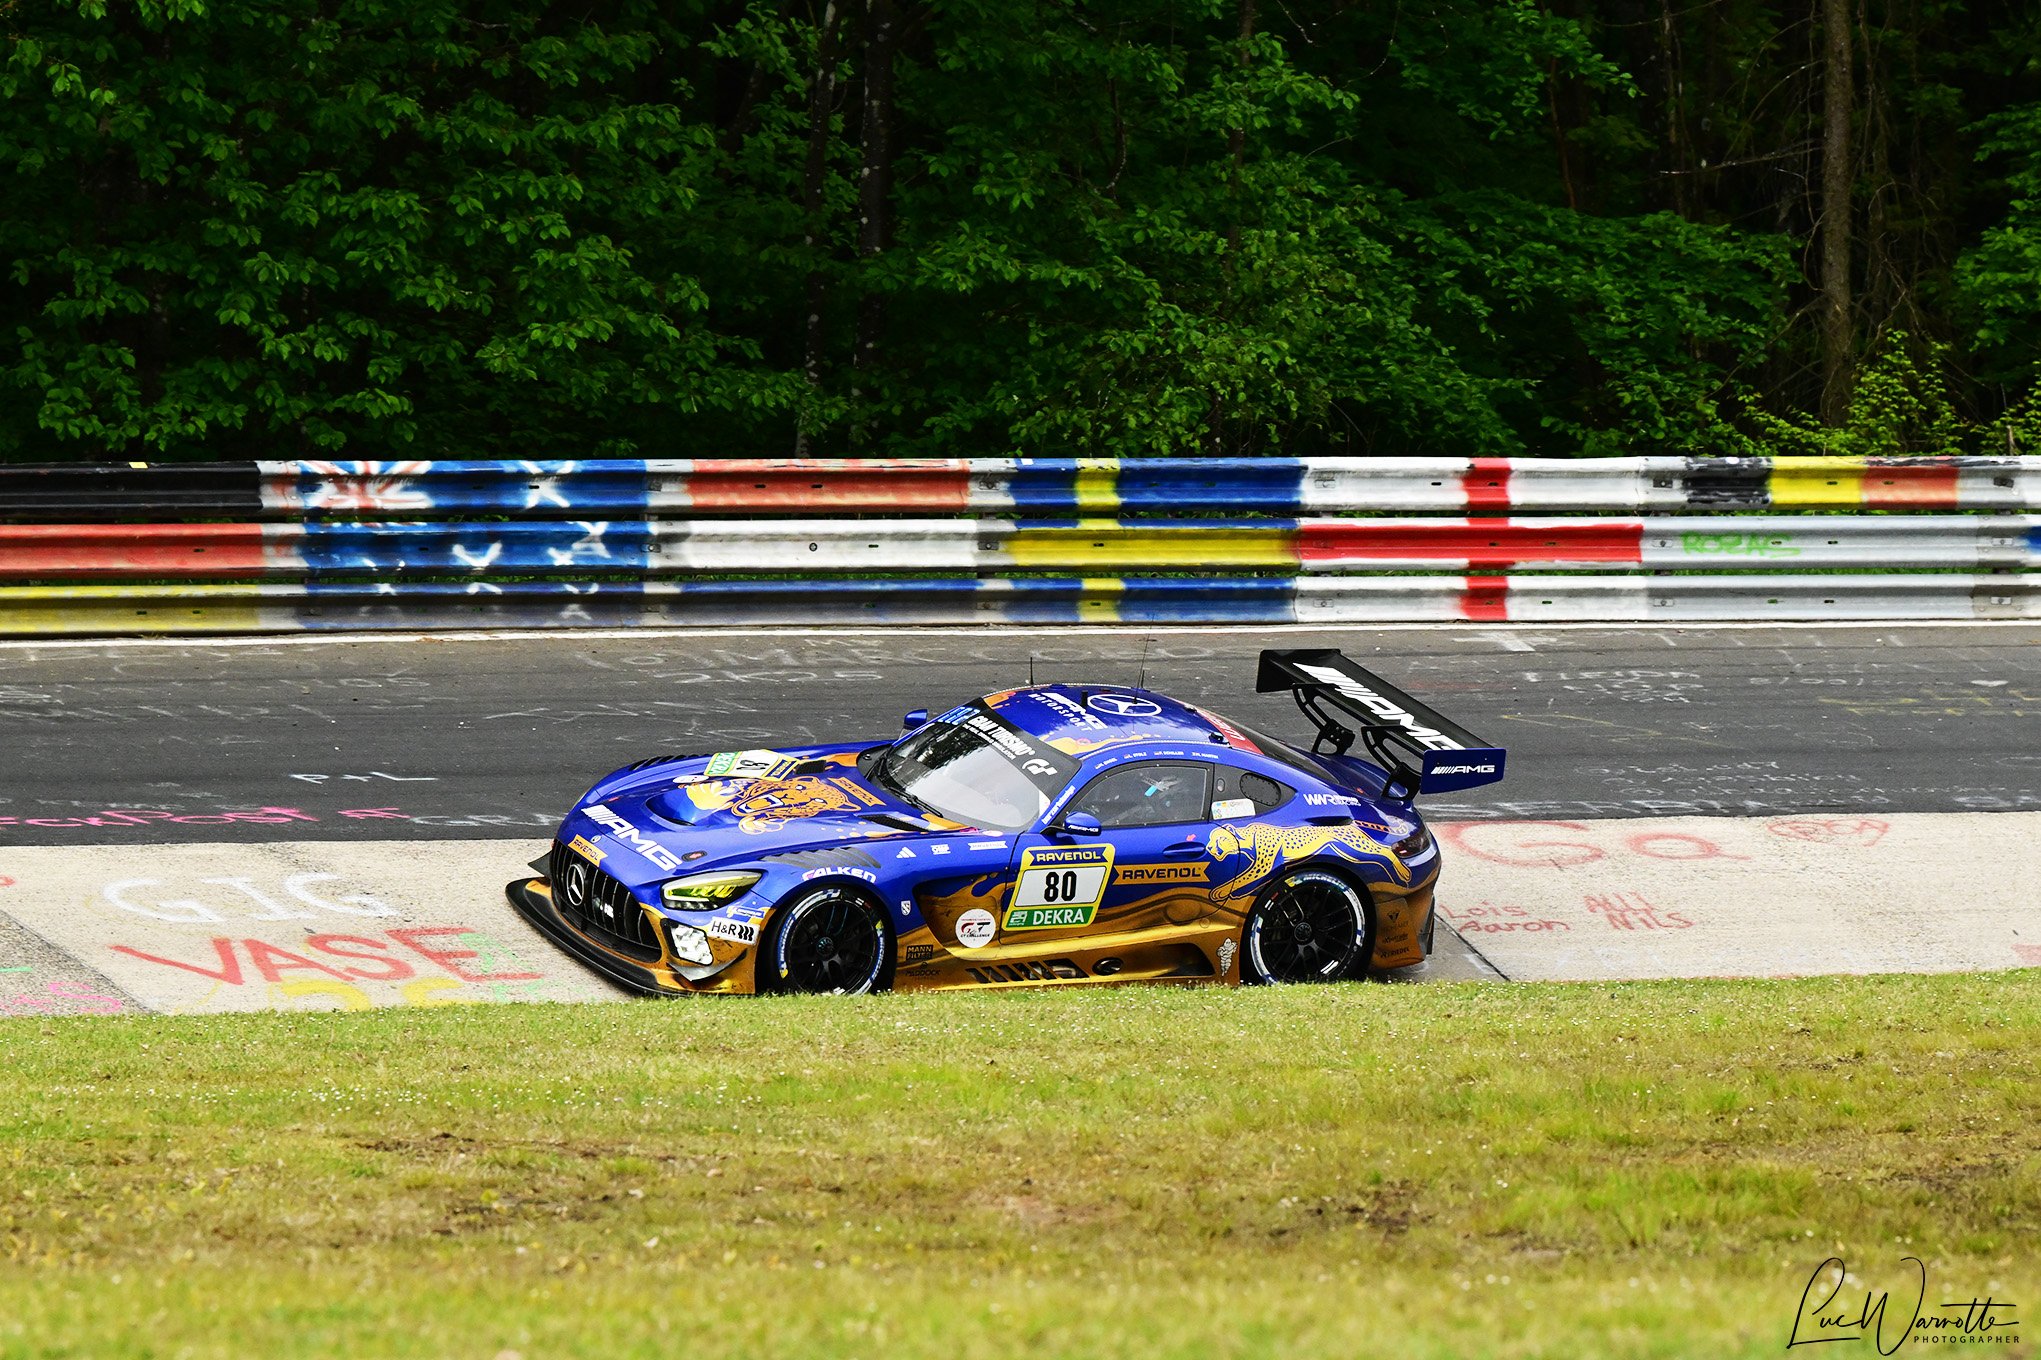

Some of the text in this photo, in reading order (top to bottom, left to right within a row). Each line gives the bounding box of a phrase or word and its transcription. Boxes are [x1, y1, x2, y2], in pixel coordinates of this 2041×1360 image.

[1027, 693, 1092, 731] MOTORSPORT
[709, 751, 737, 775] DEKRA
[573, 838, 600, 862] RAVENOL
[604, 816, 683, 872] AMG
[1036, 850, 1102, 863] RAVENOL
[801, 866, 877, 884] FALKEN
[1121, 866, 1201, 880] RAVENOL
[1043, 871, 1078, 903] 80
[1032, 908, 1085, 926] DEKRA
[711, 921, 737, 937] H&R
[106, 926, 545, 985] VASE
[908, 945, 932, 953] MANN
